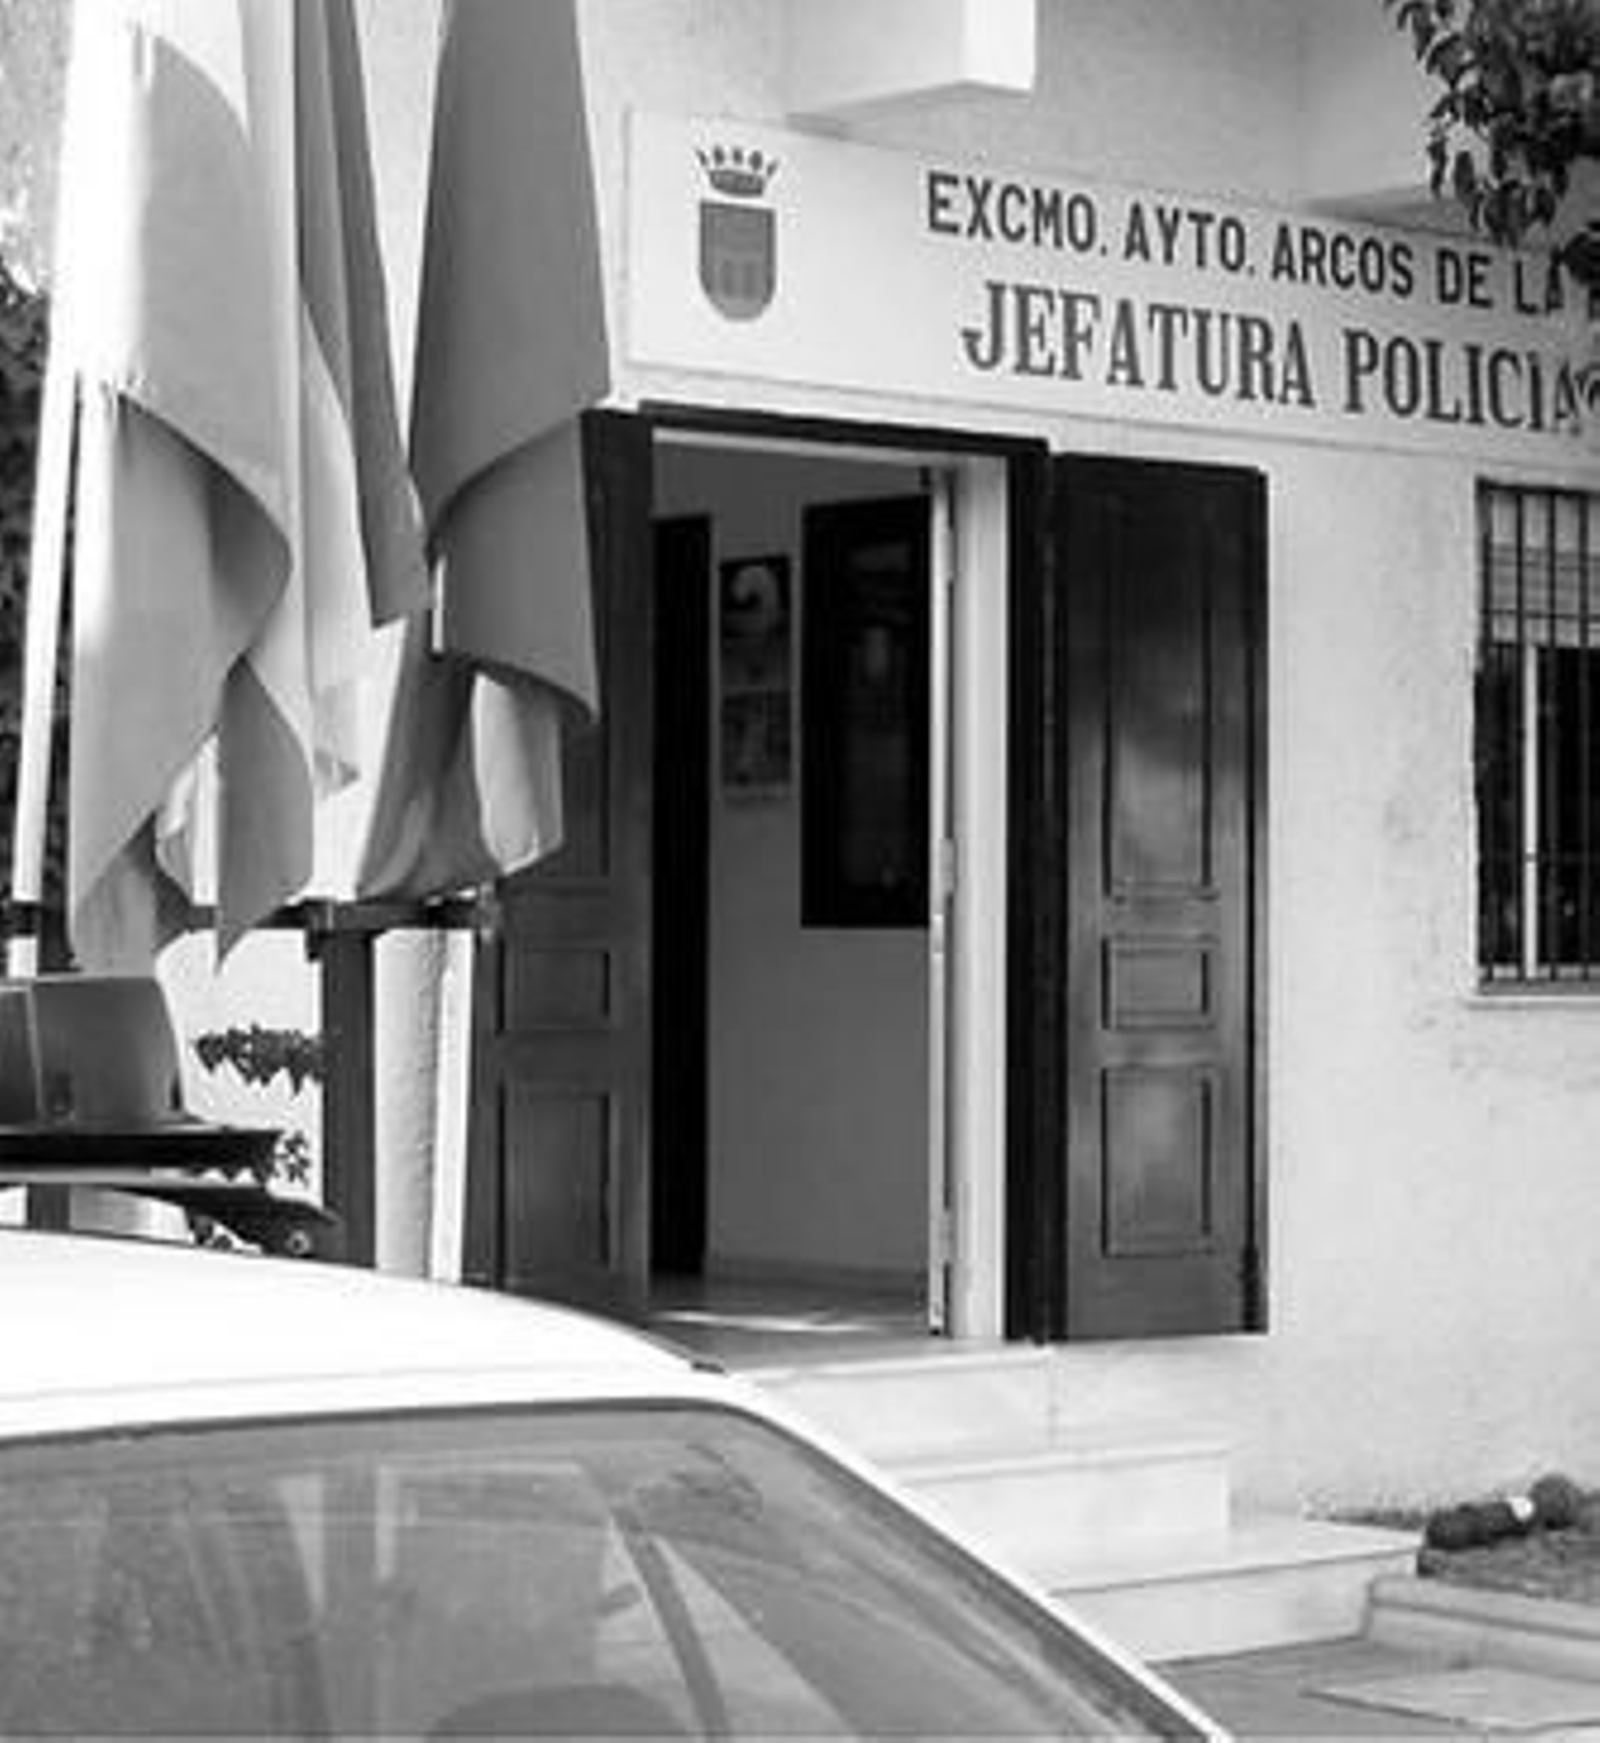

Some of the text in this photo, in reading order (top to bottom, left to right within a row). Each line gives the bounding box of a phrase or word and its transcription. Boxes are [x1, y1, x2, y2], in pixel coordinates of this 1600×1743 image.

[927, 170, 1108, 256] EXCMO.
[1124, 203, 1255, 276] AYTO.
[1272, 223, 1413, 297] ARCOS
[1437, 247, 1493, 309] DE
[962, 279, 1316, 408] JEFATURA
